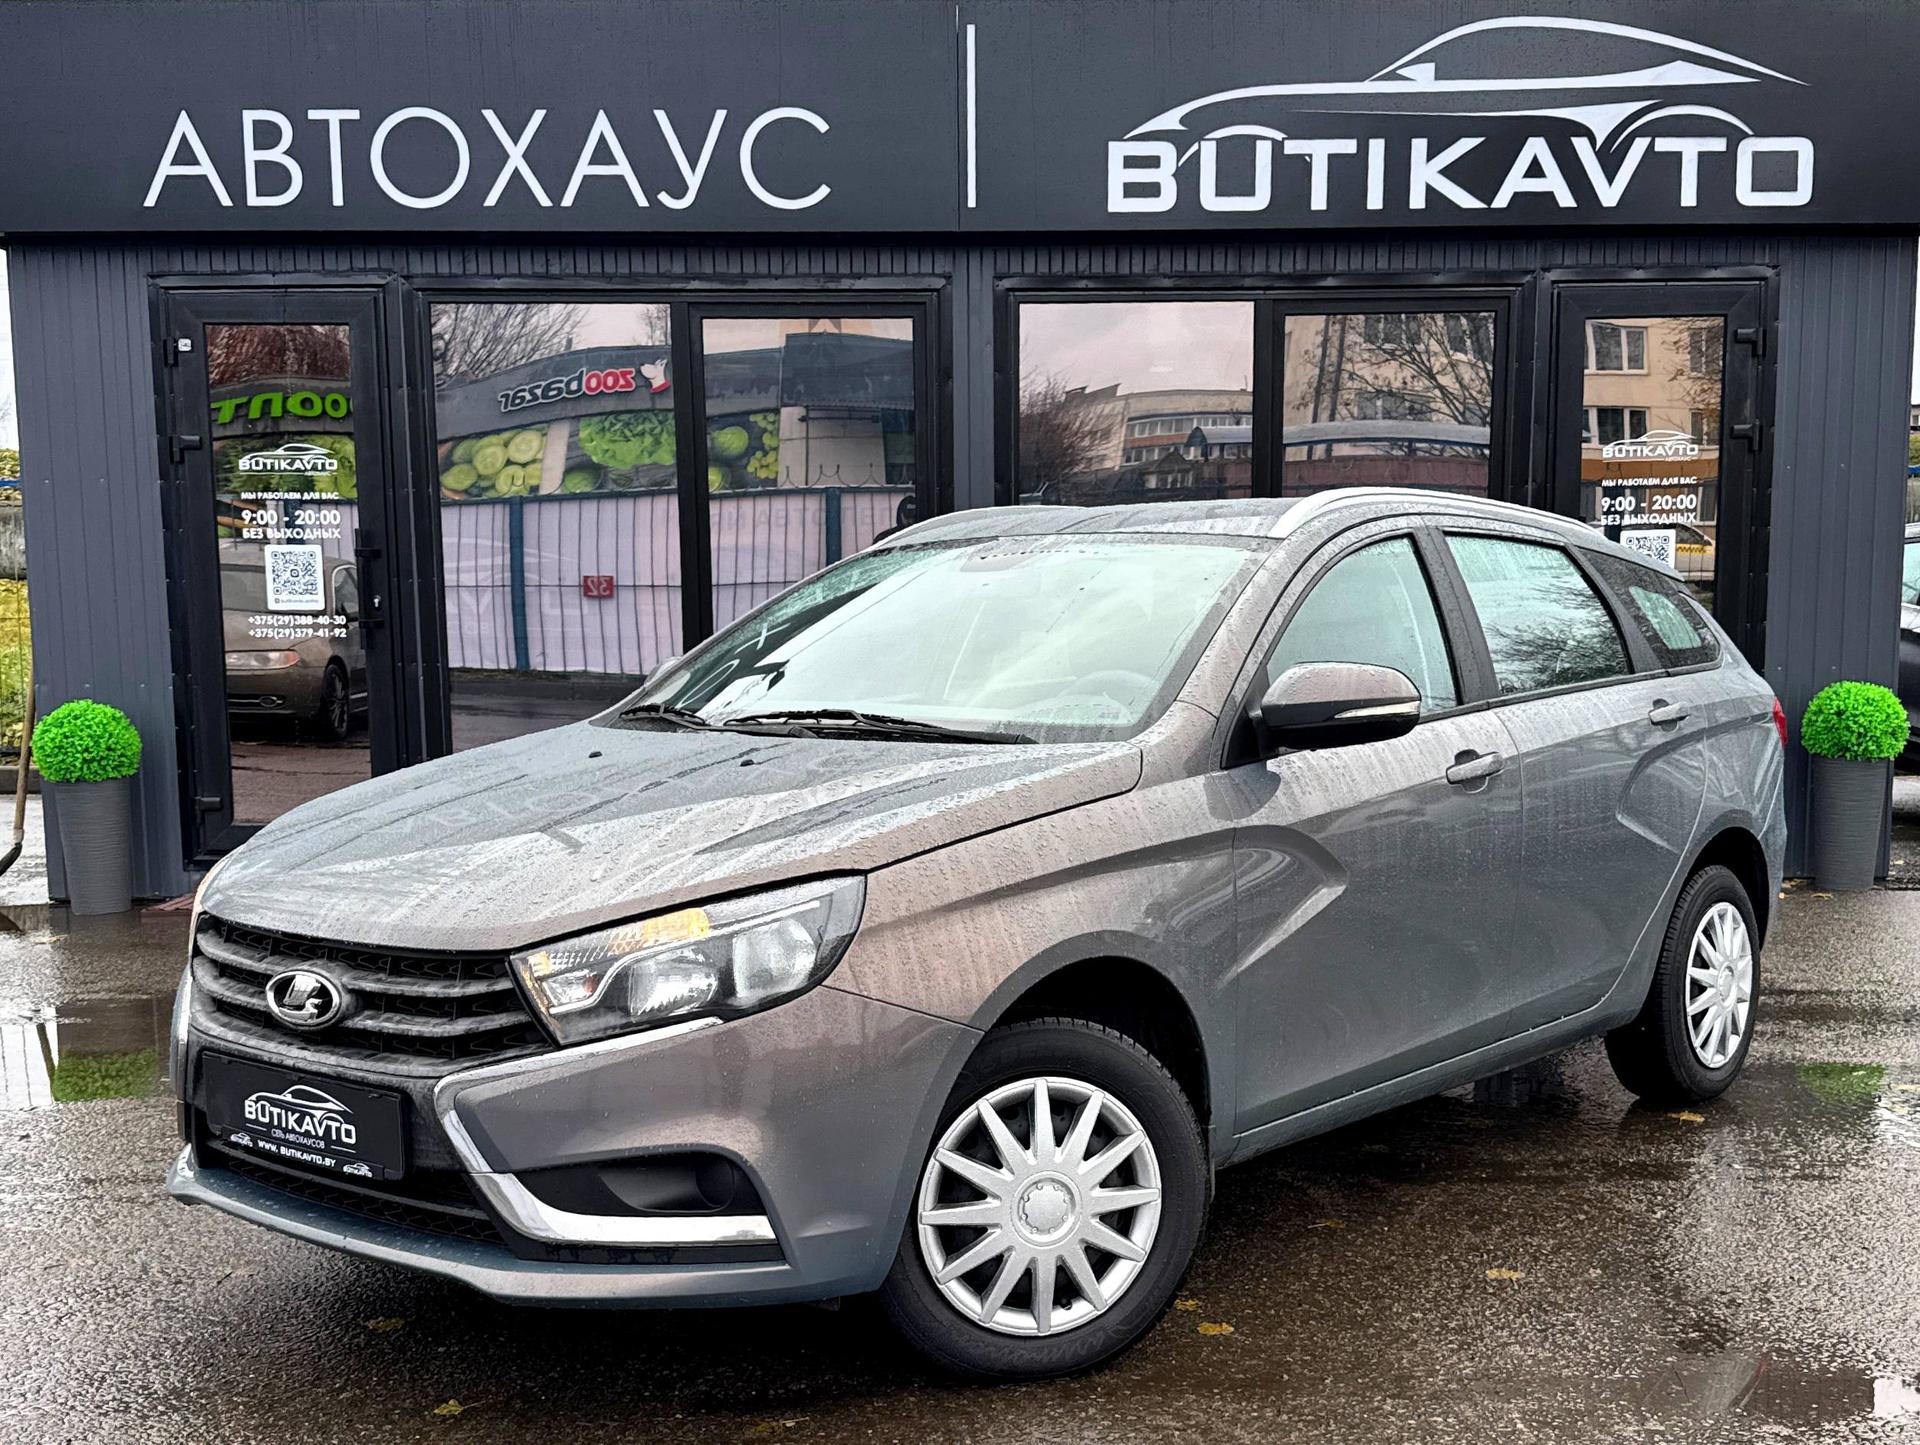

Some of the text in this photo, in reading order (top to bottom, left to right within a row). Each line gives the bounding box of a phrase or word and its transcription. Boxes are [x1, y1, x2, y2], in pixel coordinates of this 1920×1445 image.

[143, 106, 831, 210] АВТОХАУС
[1107, 136, 1815, 213] BUTIKAVTO
[1602, 444, 1699, 458] BUTIKAVTO
[238, 458, 338, 471] BUTIKAVTO
[1601, 476, 1697, 487] МЫ РАБОТАЕМ ДЛЯ ВАС
[241, 491, 339, 501] МЫ РАБОТАЕМ ДЛЯ ВАС
[1600, 496, 1636, 512] 9:00
[1651, 494, 1697, 510] 20:00
[241, 510, 278, 525] 9:00
[294, 510, 341, 525] 20:00
[1600, 512, 1697, 526] БЕЗ ВЫХОДНЫХ
[242, 528, 341, 540] БЕЗ ВЫХОДНЫХ
[248, 615, 347, 626] +375(29)388-40-30
[248, 628, 348, 638] +375(29)379-41-92
[244, 1099, 357, 1145] BUTIKAVTO
